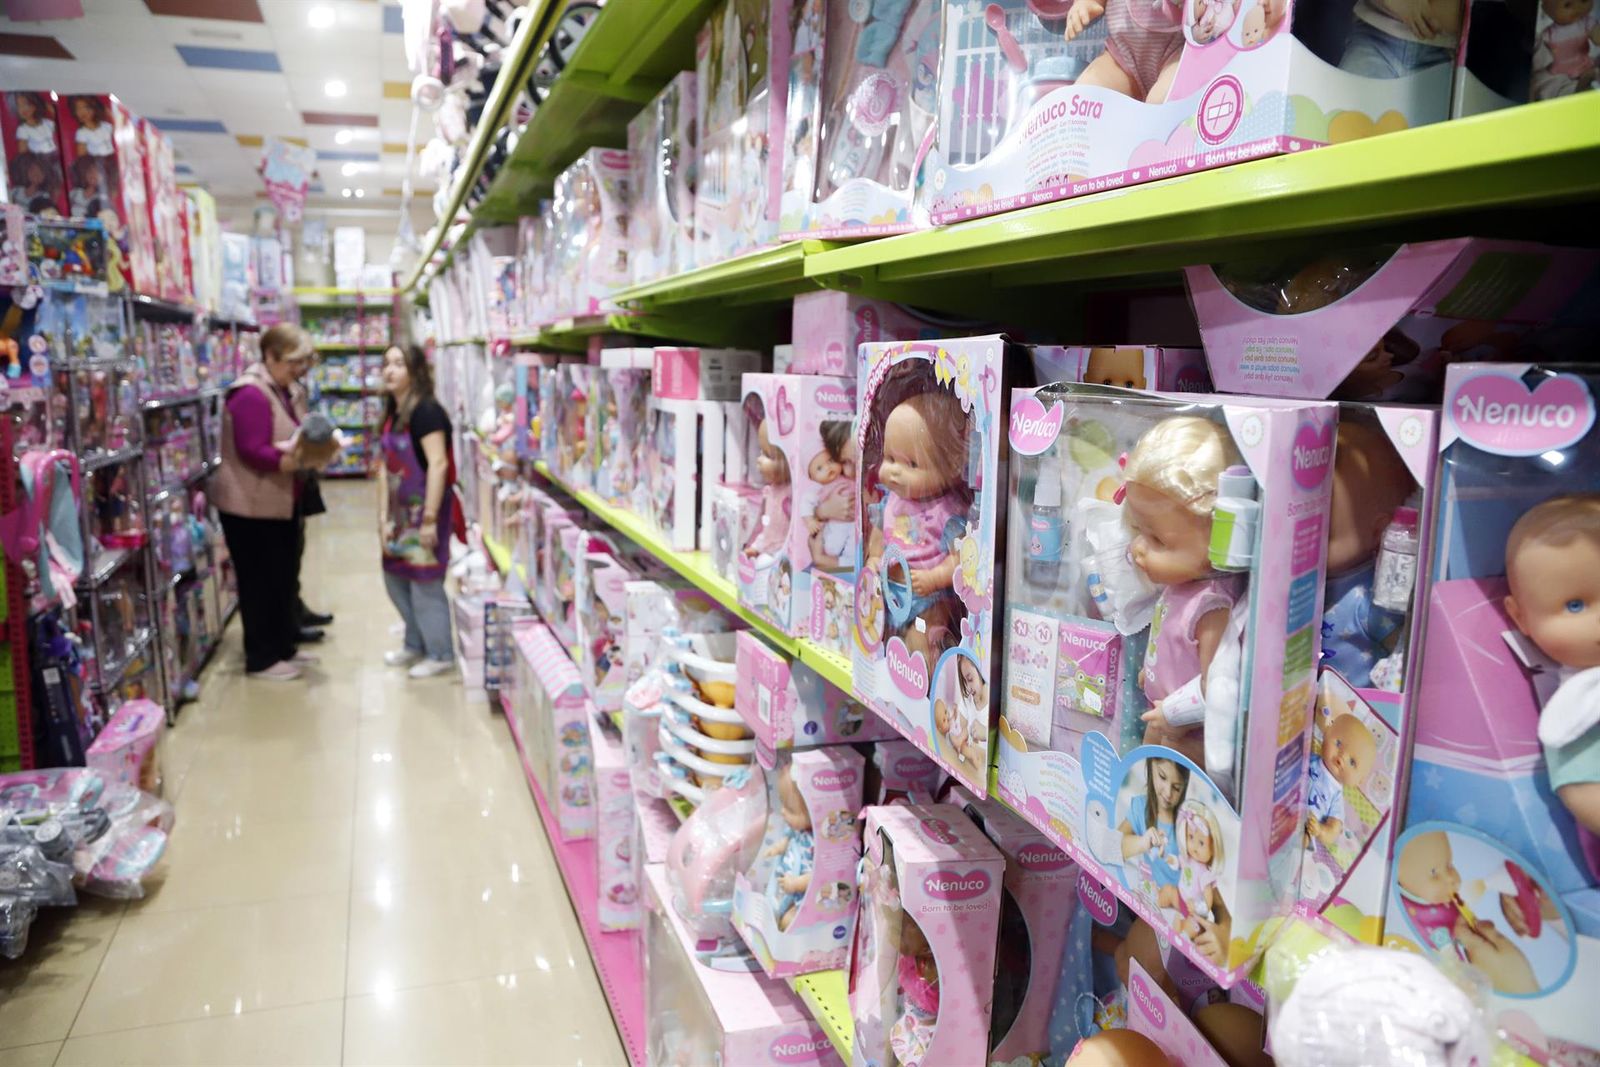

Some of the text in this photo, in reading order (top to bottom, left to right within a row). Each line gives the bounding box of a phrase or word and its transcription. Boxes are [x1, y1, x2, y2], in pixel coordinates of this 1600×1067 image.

[1070, 94, 1104, 120] Sara
[1148, 162, 1177, 178] Nenuco
[1205, 151, 1226, 166] Born
[1073, 182, 1089, 194] Born
[1096, 177, 1105, 190] be
[1105, 174, 1125, 188] loved
[1032, 191, 1054, 205] Nenuco
[1456, 393, 1576, 429] Nenuco
[1012, 411, 1057, 438] Nenuco
[1293, 444, 1330, 471] Nenuco
[1061, 631, 1106, 652] Nenuco
[888, 649, 924, 690] Nenuco
[1104, 649, 1118, 708] Nenuco
[813, 774, 854, 786] Nenuco
[1019, 851, 1072, 865] Nenuco
[1077, 850, 1099, 875] Nenuco
[925, 879, 984, 892] Nenuco
[1080, 876, 1113, 918] Nenuco
[922, 902, 988, 913] Born to be loved
[1117, 884, 1133, 905] Born
[1150, 910, 1169, 936] loved
[1188, 945, 1219, 979] Nenuco
[1244, 976, 1266, 1000] nuco
[1132, 979, 1163, 1024] Nenuco
[773, 1040, 832, 1058] Nenuco
